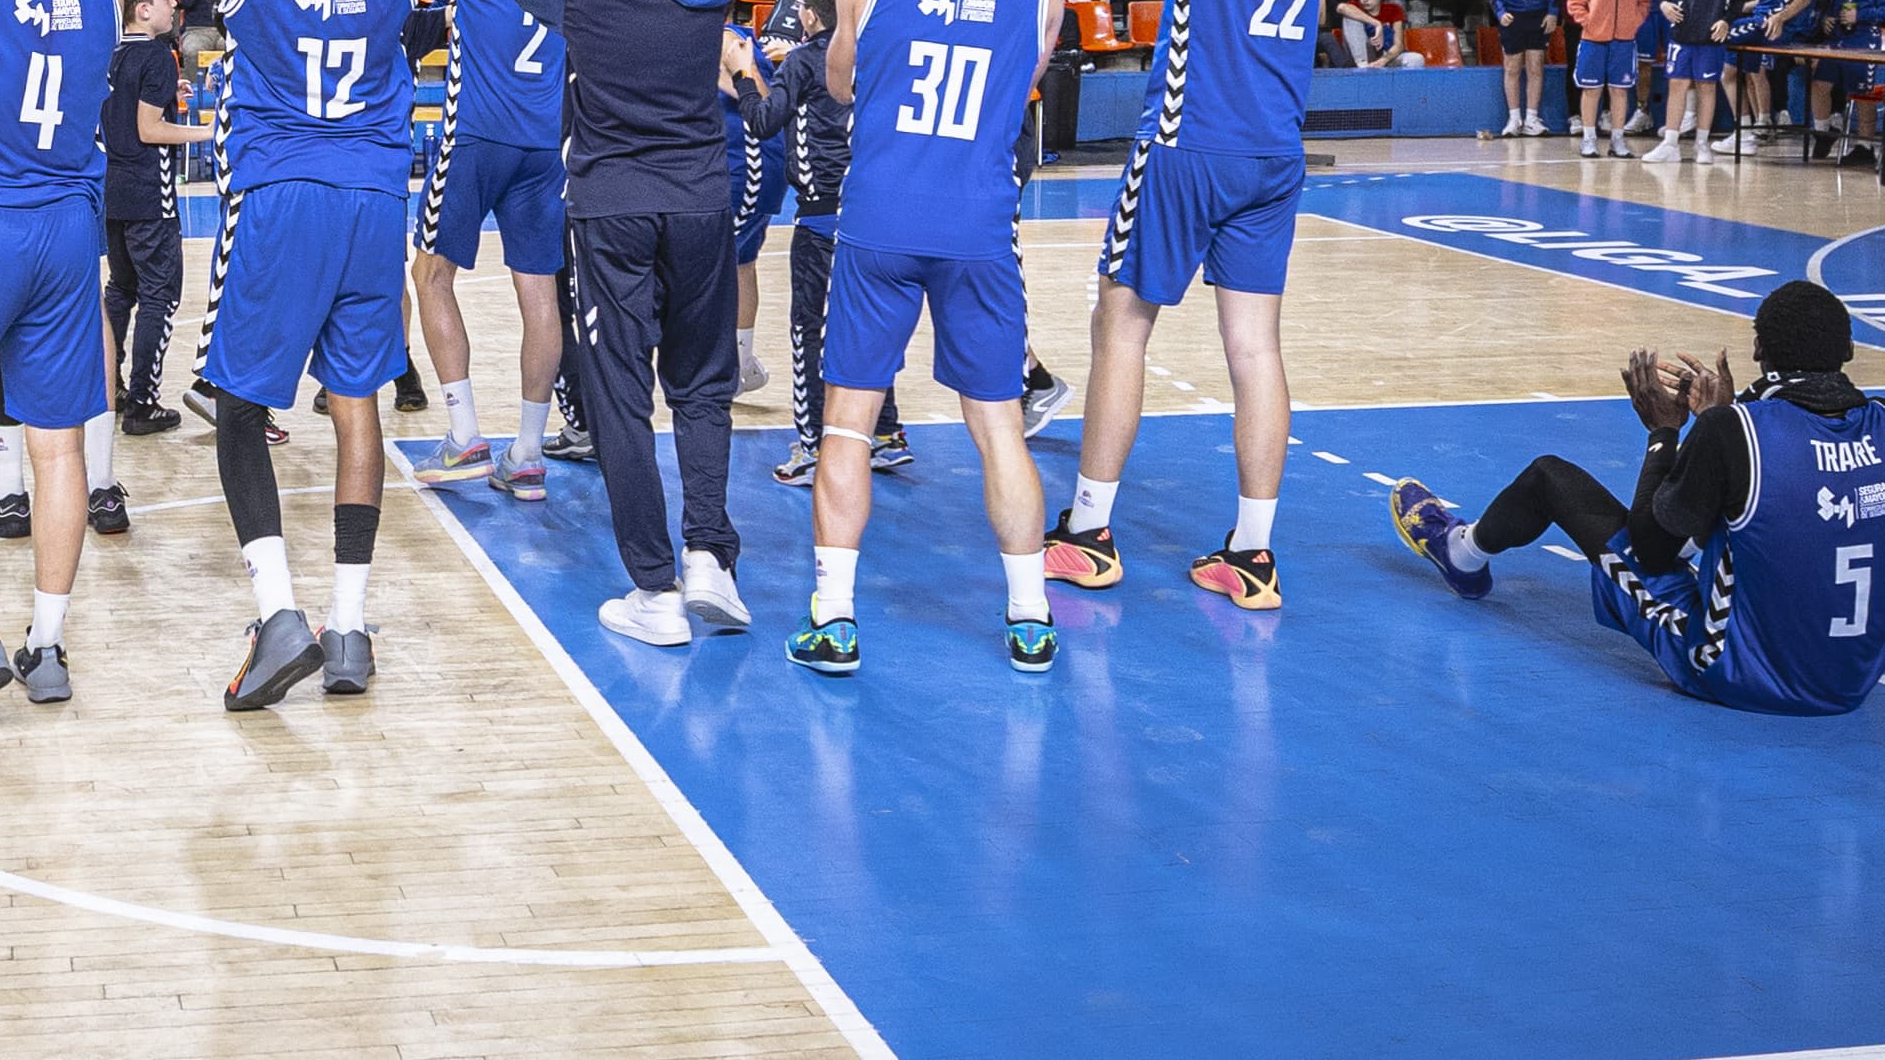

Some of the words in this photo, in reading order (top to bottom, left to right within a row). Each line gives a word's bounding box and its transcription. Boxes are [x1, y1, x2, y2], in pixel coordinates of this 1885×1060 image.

[19, 52, 64, 150] 4
[298, 37, 368, 119] 12
[896, 40, 993, 141] 30
[1829, 543, 1875, 638] 5
